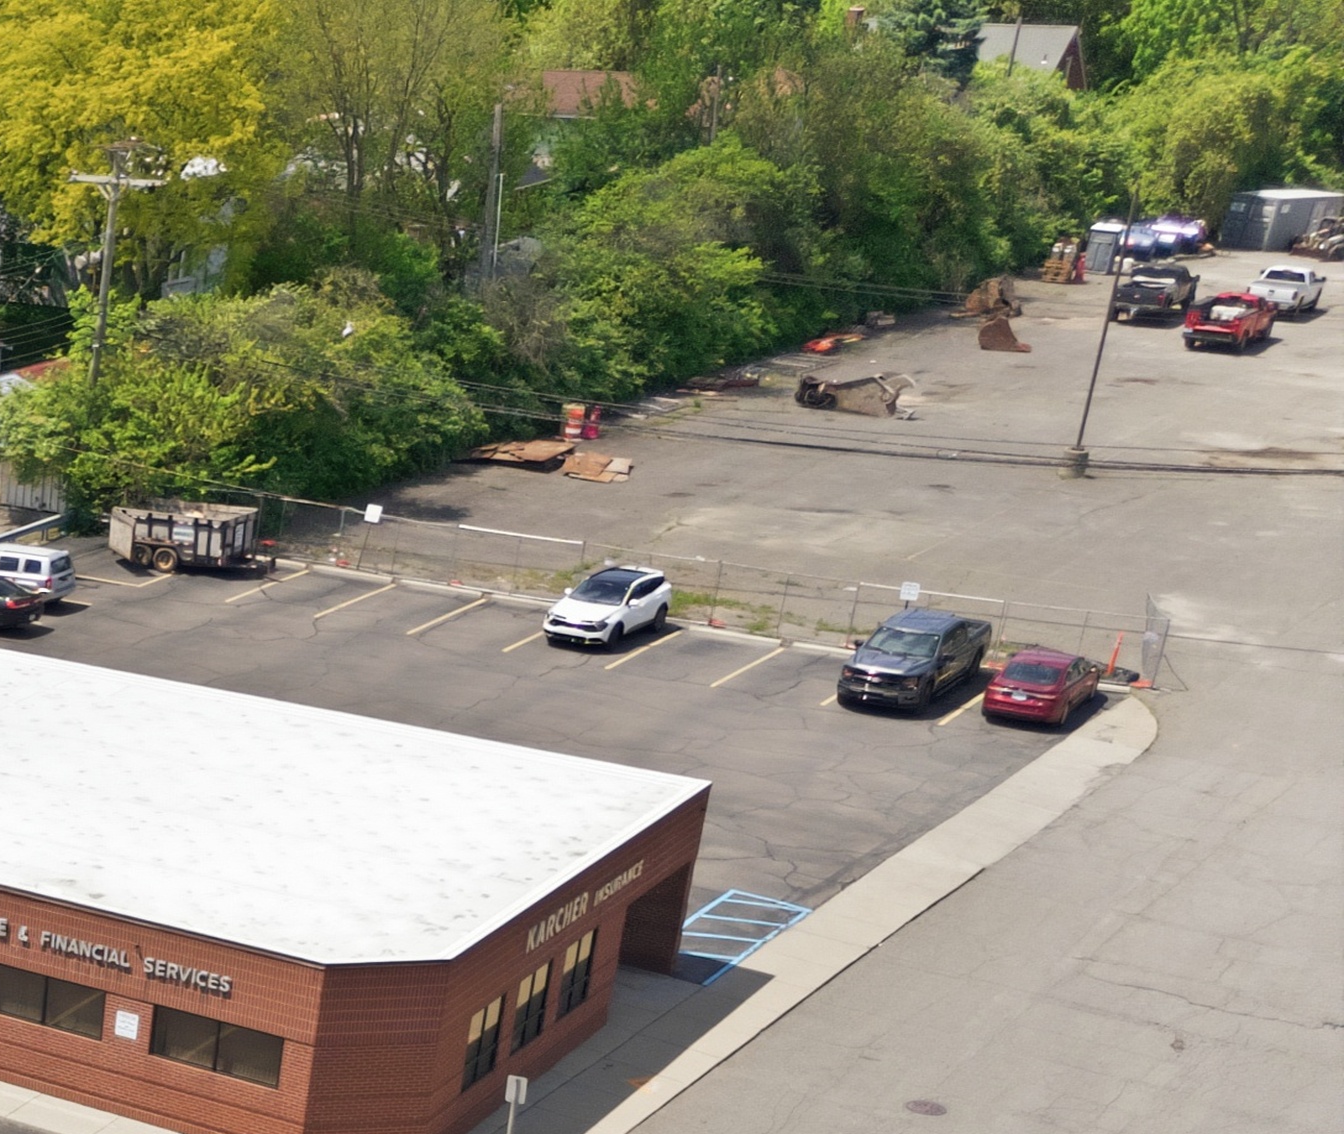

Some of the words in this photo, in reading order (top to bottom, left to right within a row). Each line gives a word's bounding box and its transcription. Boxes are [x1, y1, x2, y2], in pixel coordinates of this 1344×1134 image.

[526, 891, 589, 955] KARCHER
[593, 859, 645, 907] INSURANCE
[18, 925, 29, 942] &
[40, 930, 131, 968] FINANCIAL
[144, 956, 232, 993] SERVICES
